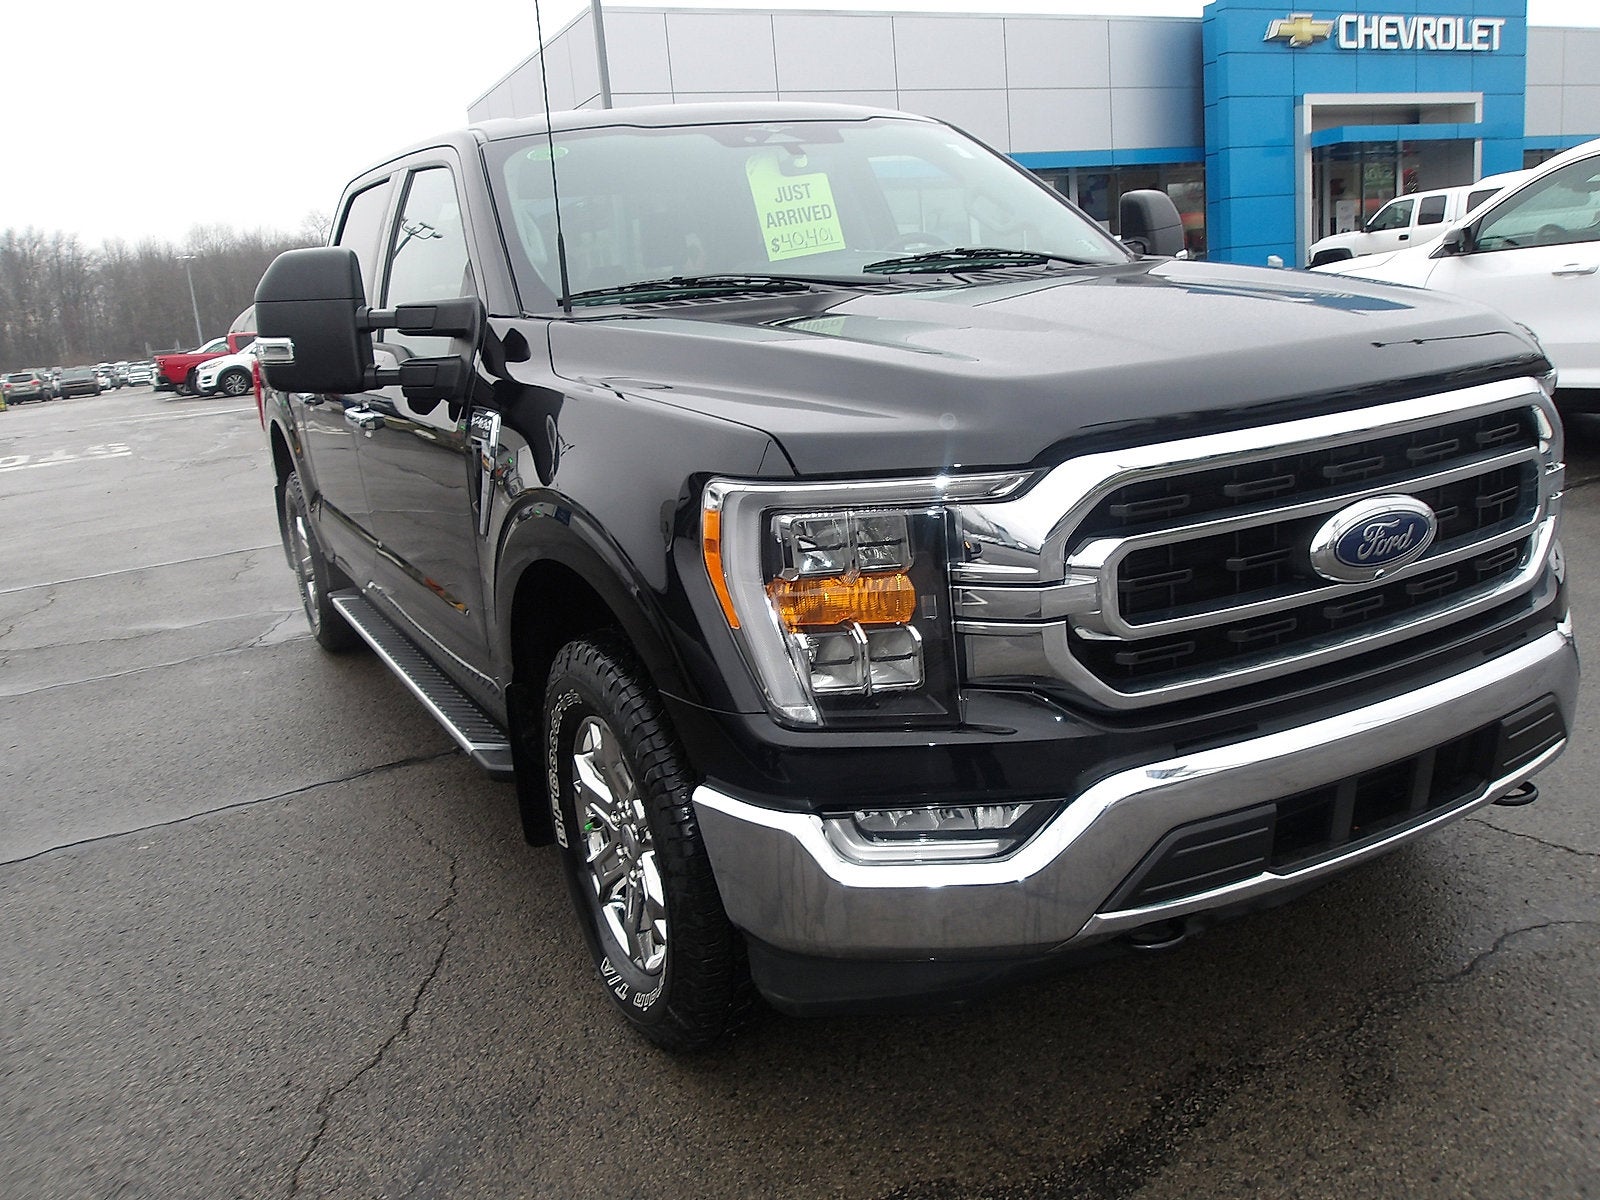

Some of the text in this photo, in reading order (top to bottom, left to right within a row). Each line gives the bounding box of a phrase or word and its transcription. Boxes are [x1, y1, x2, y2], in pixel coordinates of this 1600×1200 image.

[1336, 14, 1506, 51] CHEVROLET
[774, 182, 811, 204] JUST
[766, 203, 832, 229] ARRIVED
[1357, 518, 1415, 560] Ford
